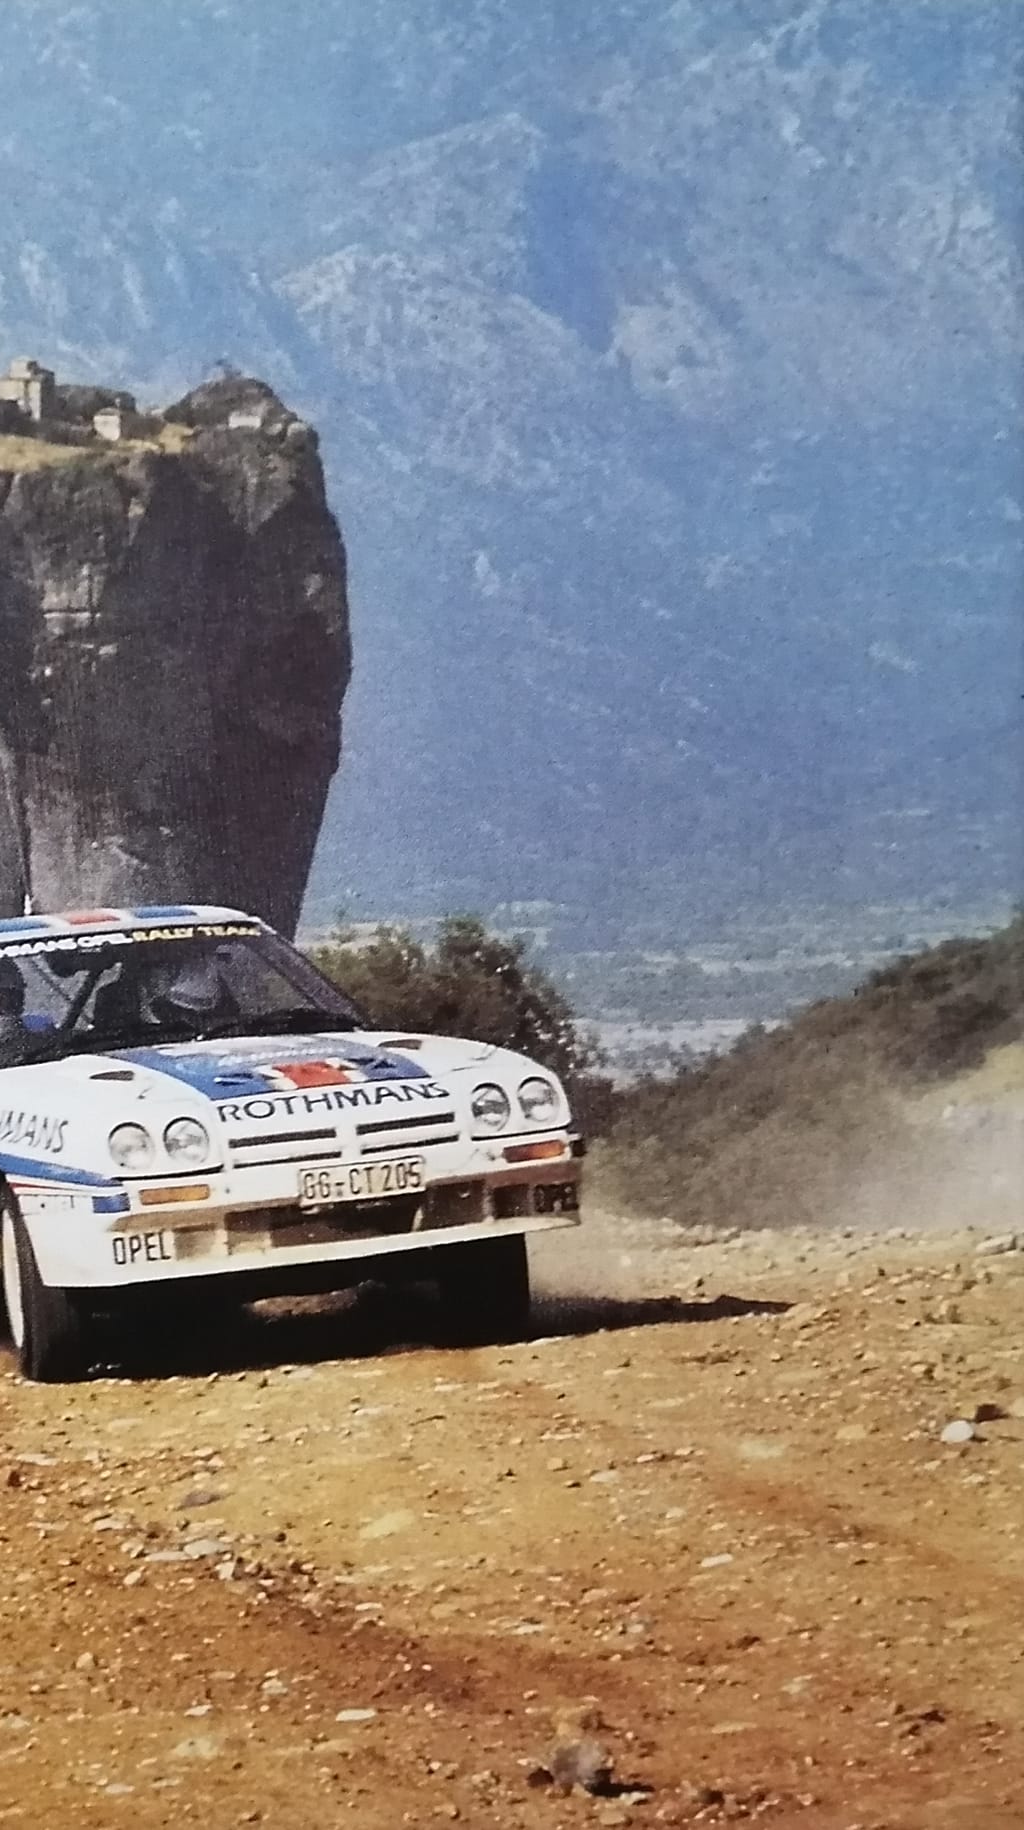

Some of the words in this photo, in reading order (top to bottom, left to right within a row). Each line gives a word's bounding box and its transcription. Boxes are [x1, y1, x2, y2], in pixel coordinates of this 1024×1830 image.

[77, 932, 133, 948] OPEL
[132, 927, 193, 942] RALLY
[197, 925, 262, 938] TEAM
[218, 1080, 450, 1123] ROTHMANS
[381, 1159, 422, 1191] 205
[112, 1230, 171, 1265] OPEL
